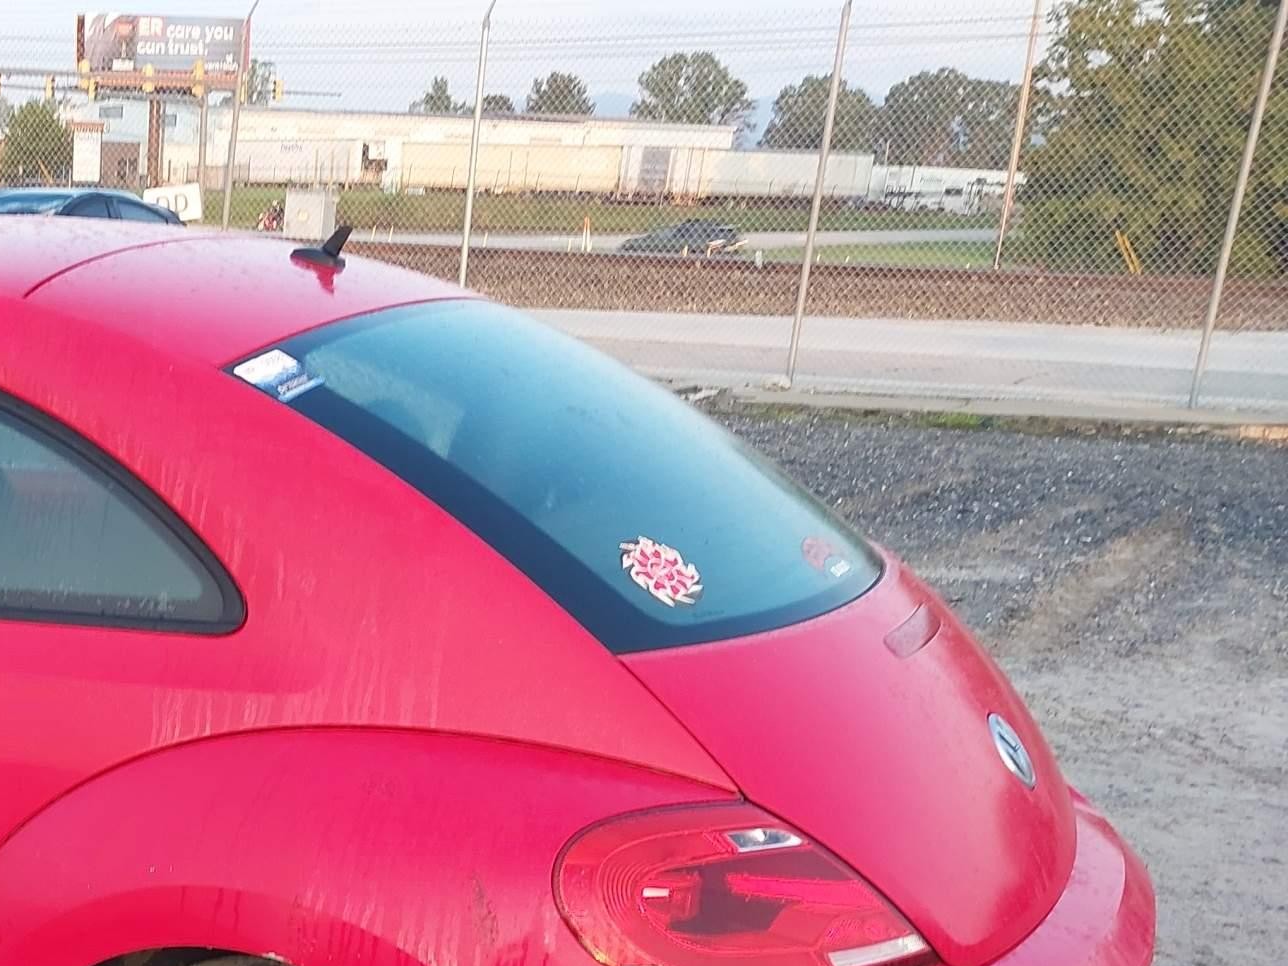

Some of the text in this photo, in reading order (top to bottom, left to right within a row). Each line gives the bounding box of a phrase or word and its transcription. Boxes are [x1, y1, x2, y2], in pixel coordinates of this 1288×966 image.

[138, 16, 234, 42] ER care you
[136, 41, 165, 55] can
